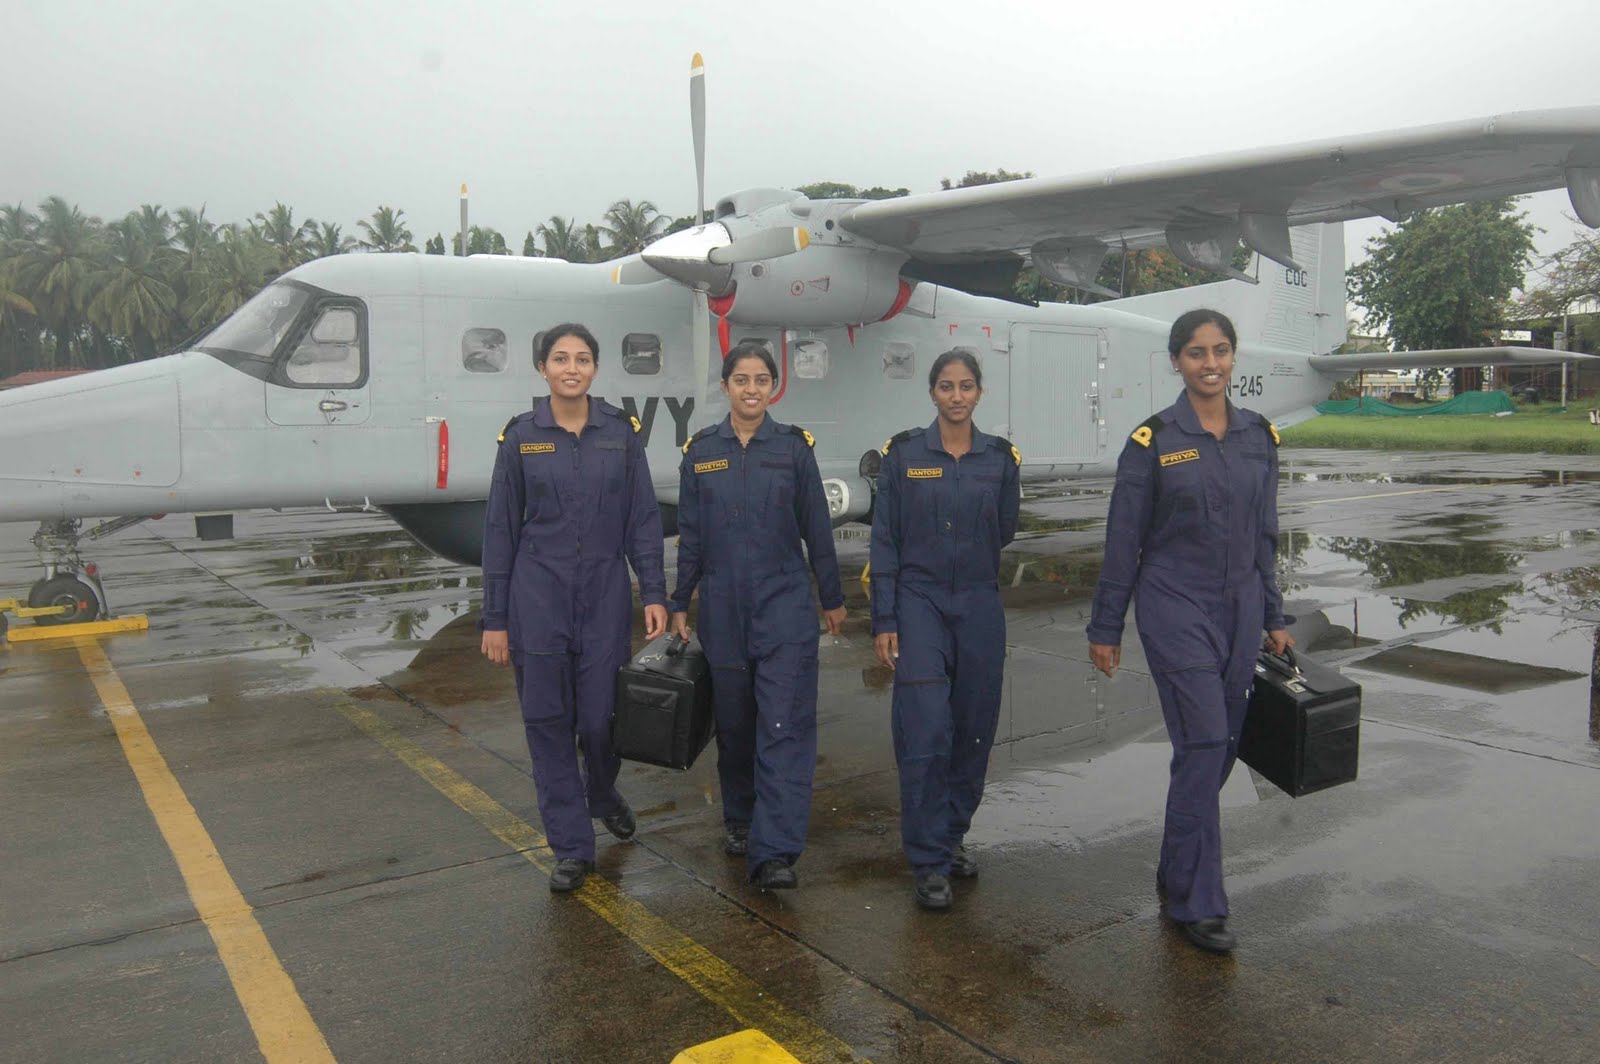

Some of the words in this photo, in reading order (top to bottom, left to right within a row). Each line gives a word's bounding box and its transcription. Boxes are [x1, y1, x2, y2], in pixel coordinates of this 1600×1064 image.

[521, 443, 554, 452] SANDHYA
[1161, 450, 1198, 464] PRIYA
[696, 460, 727, 471] SWETHA
